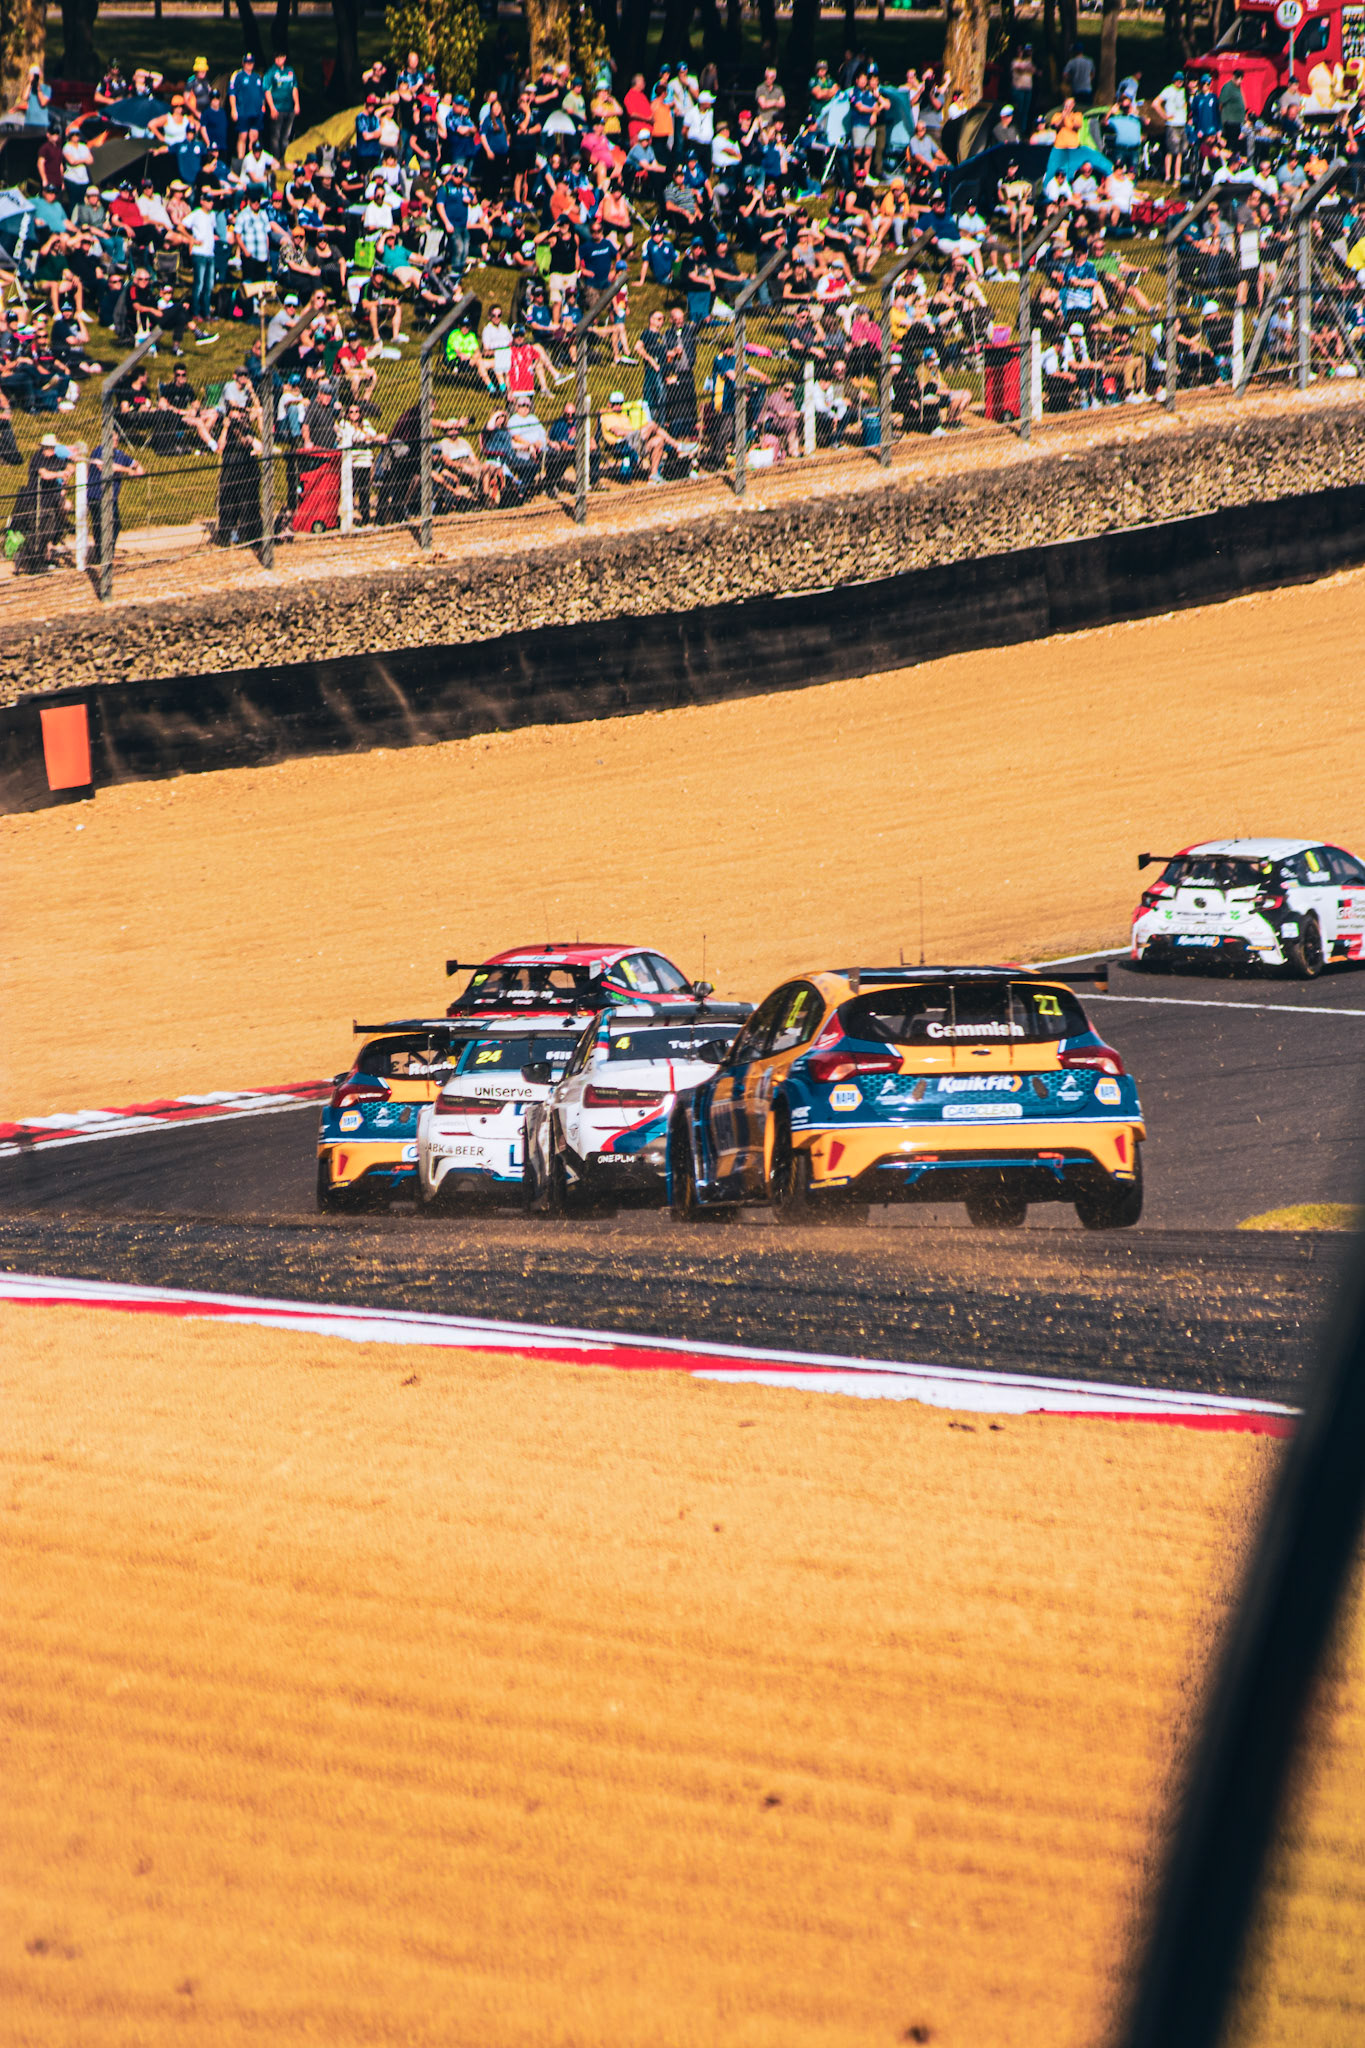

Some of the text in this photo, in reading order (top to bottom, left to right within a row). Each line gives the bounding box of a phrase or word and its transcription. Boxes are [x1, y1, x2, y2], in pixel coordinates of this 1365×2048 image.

[926, 1021, 1025, 1038] Cammish
[615, 1036, 631, 1050] 4
[475, 1049, 503, 1065] 24
[947, 1105, 1018, 1117] CATACLEAN
[455, 1145, 485, 1156] BEER
[597, 1154, 636, 1164] ONEPLM
